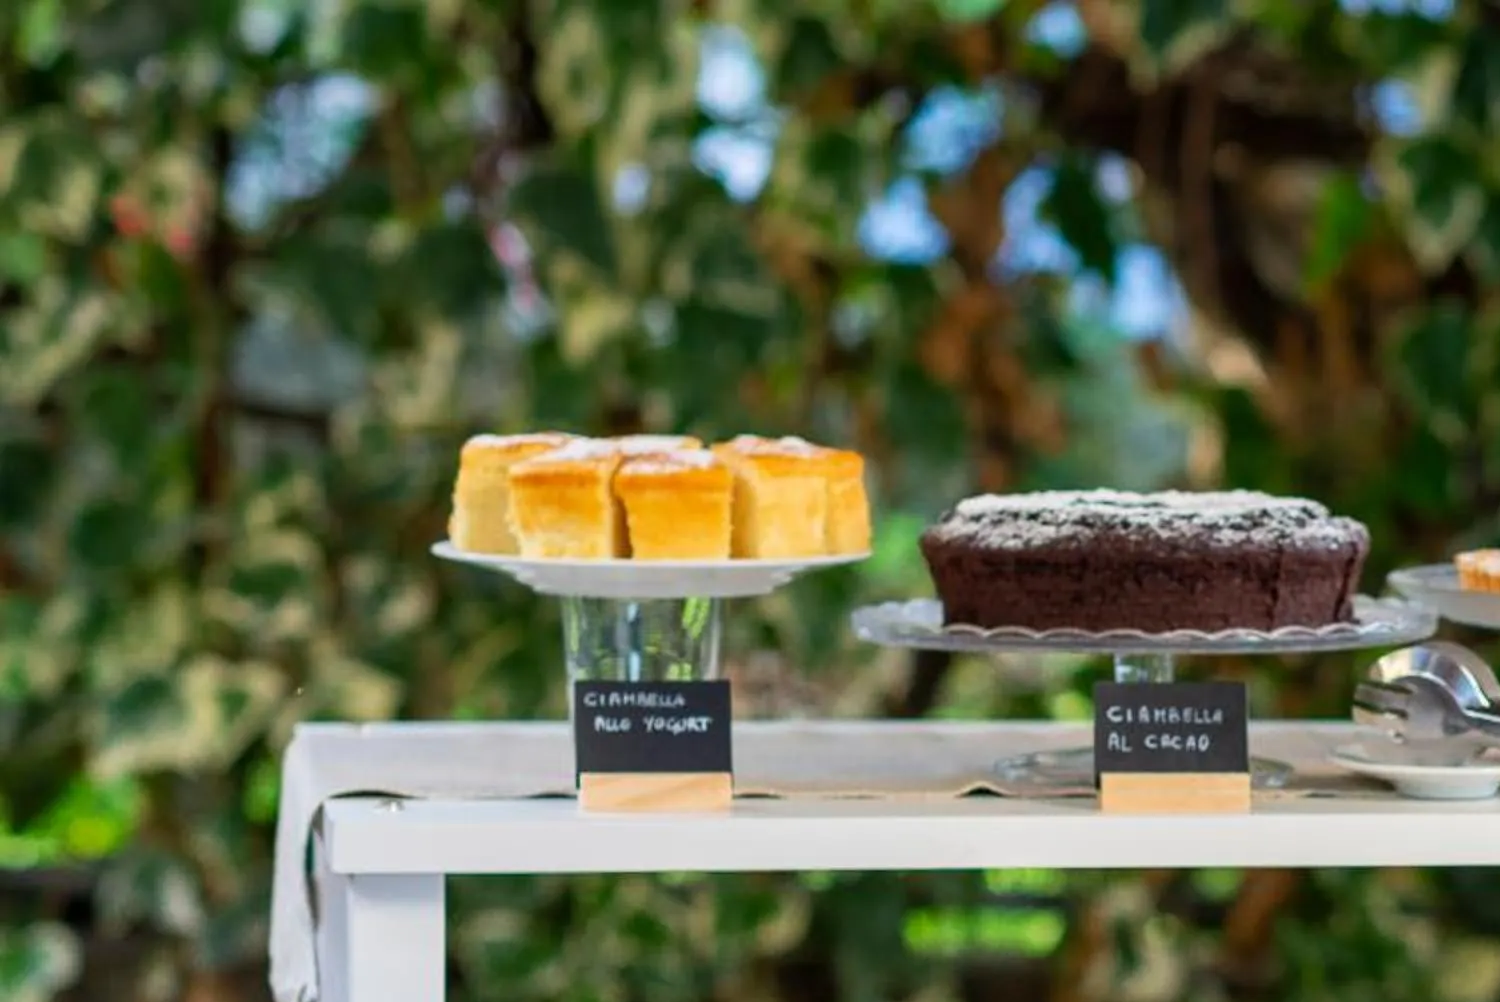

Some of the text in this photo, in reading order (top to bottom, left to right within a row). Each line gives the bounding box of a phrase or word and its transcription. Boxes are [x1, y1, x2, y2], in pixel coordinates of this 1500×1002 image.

[583, 692, 686, 708] CIAMBELLA
[1106, 705, 1223, 725] CIAMBELLA
[594, 715, 713, 736] ALLO YOGURT
[1107, 732, 1210, 752] AL CACAO
